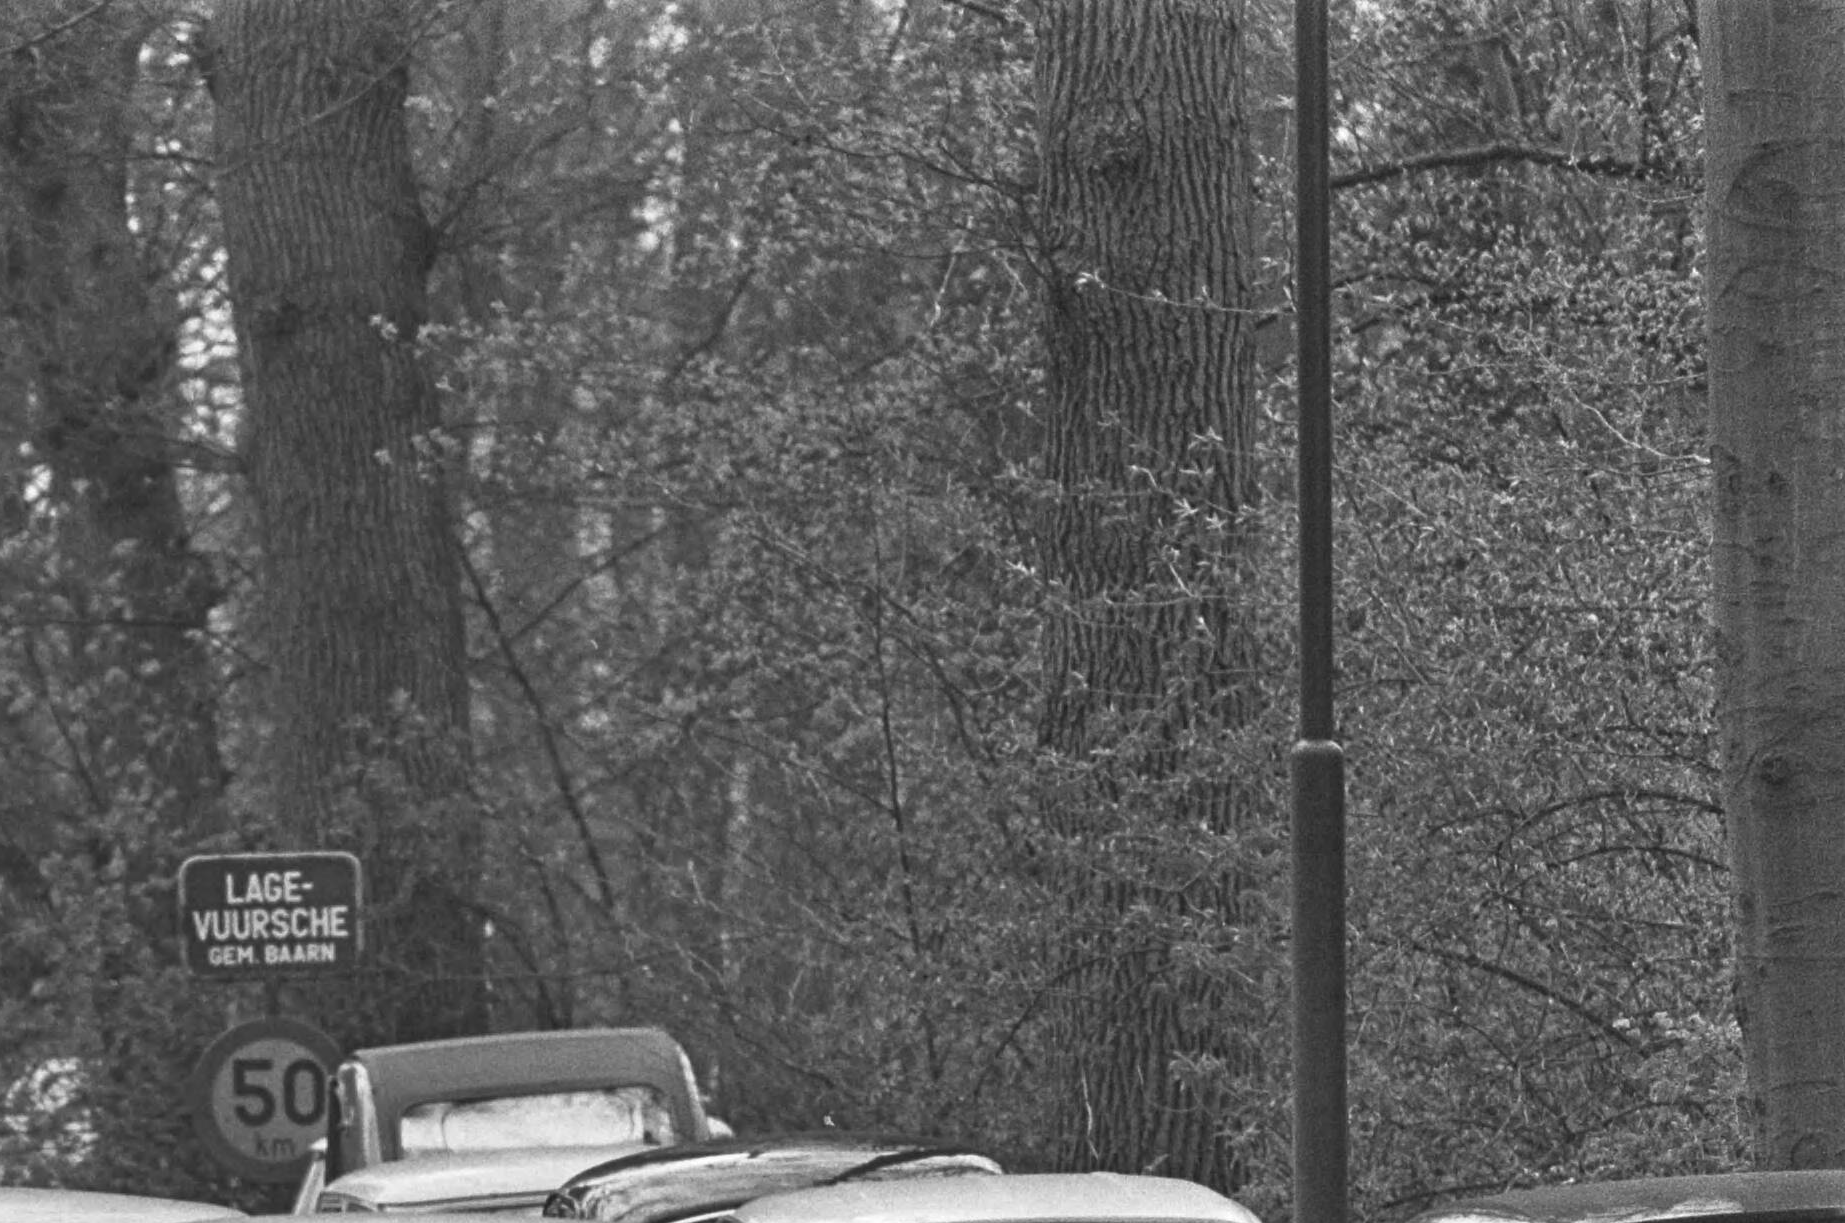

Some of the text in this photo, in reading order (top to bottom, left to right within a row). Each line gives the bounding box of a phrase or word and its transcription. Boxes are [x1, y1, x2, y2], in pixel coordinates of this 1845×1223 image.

[226, 871, 314, 905] LAGE-
[192, 905, 349, 941] VUURSCHE
[208, 943, 336, 967] GEM. BAARN
[232, 1058, 326, 1127] 50
[255, 1132, 296, 1158] km
